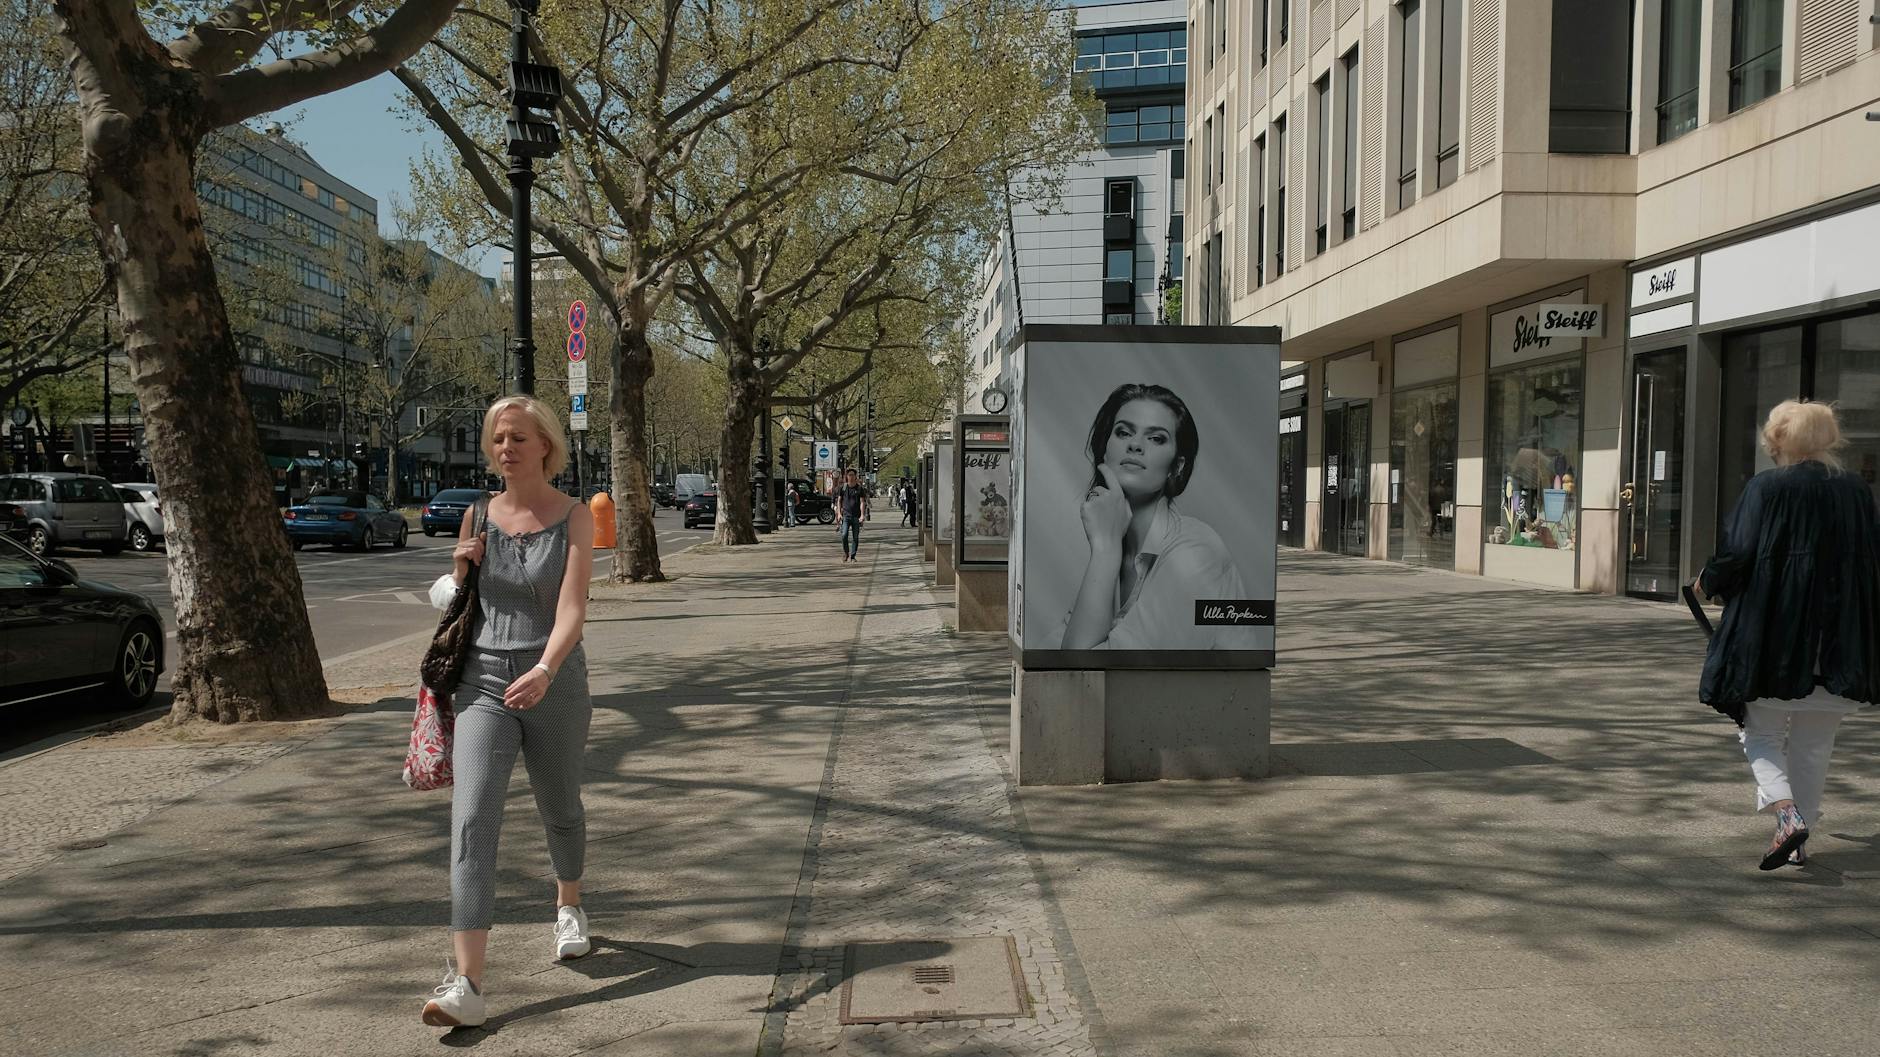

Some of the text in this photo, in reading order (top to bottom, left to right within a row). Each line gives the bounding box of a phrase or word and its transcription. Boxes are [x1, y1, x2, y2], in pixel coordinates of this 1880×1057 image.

[1649, 269, 1677, 296] Steiff
[1544, 310, 1598, 331] Steiff
[1514, 313, 1552, 352] Stei
[965, 453, 1001, 470] teiff
[1203, 605, 1267, 623] Ulla Popken
